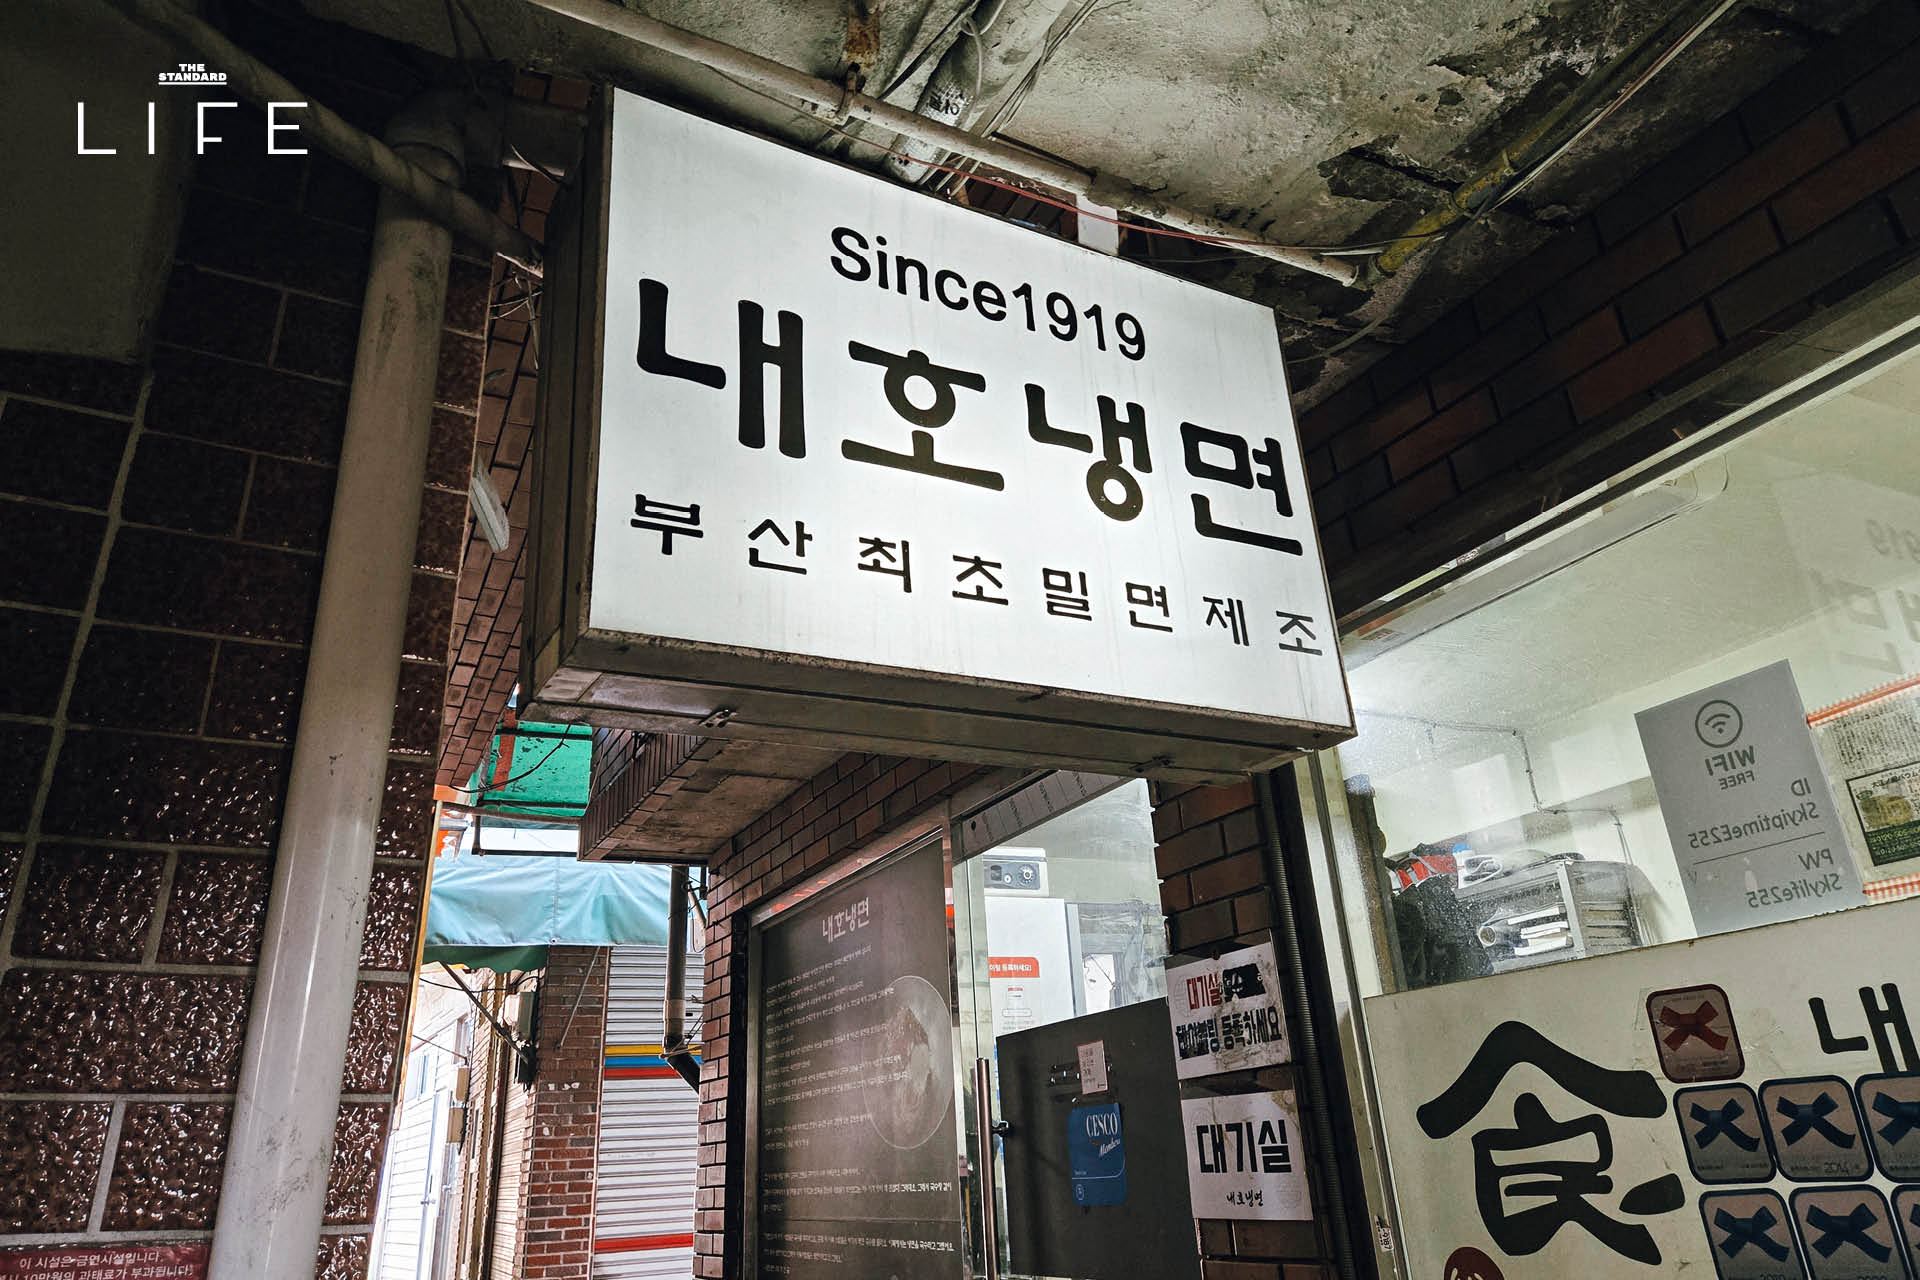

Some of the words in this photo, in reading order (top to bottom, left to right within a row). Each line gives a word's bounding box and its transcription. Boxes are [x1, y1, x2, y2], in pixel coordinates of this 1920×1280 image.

[637, 278, 1304, 556] 내호냉면
[822, 896, 870, 943] 내호냉면
[1186, 972, 1223, 1010] 대기실
[1086, 1111, 1118, 1137] CESCO
[1195, 1119, 1293, 1174] 대기실
[1415, 1019, 1686, 1267] 食
[19, 1257, 32, 1270] 이
[35, 1255, 72, 1269] 시설은
